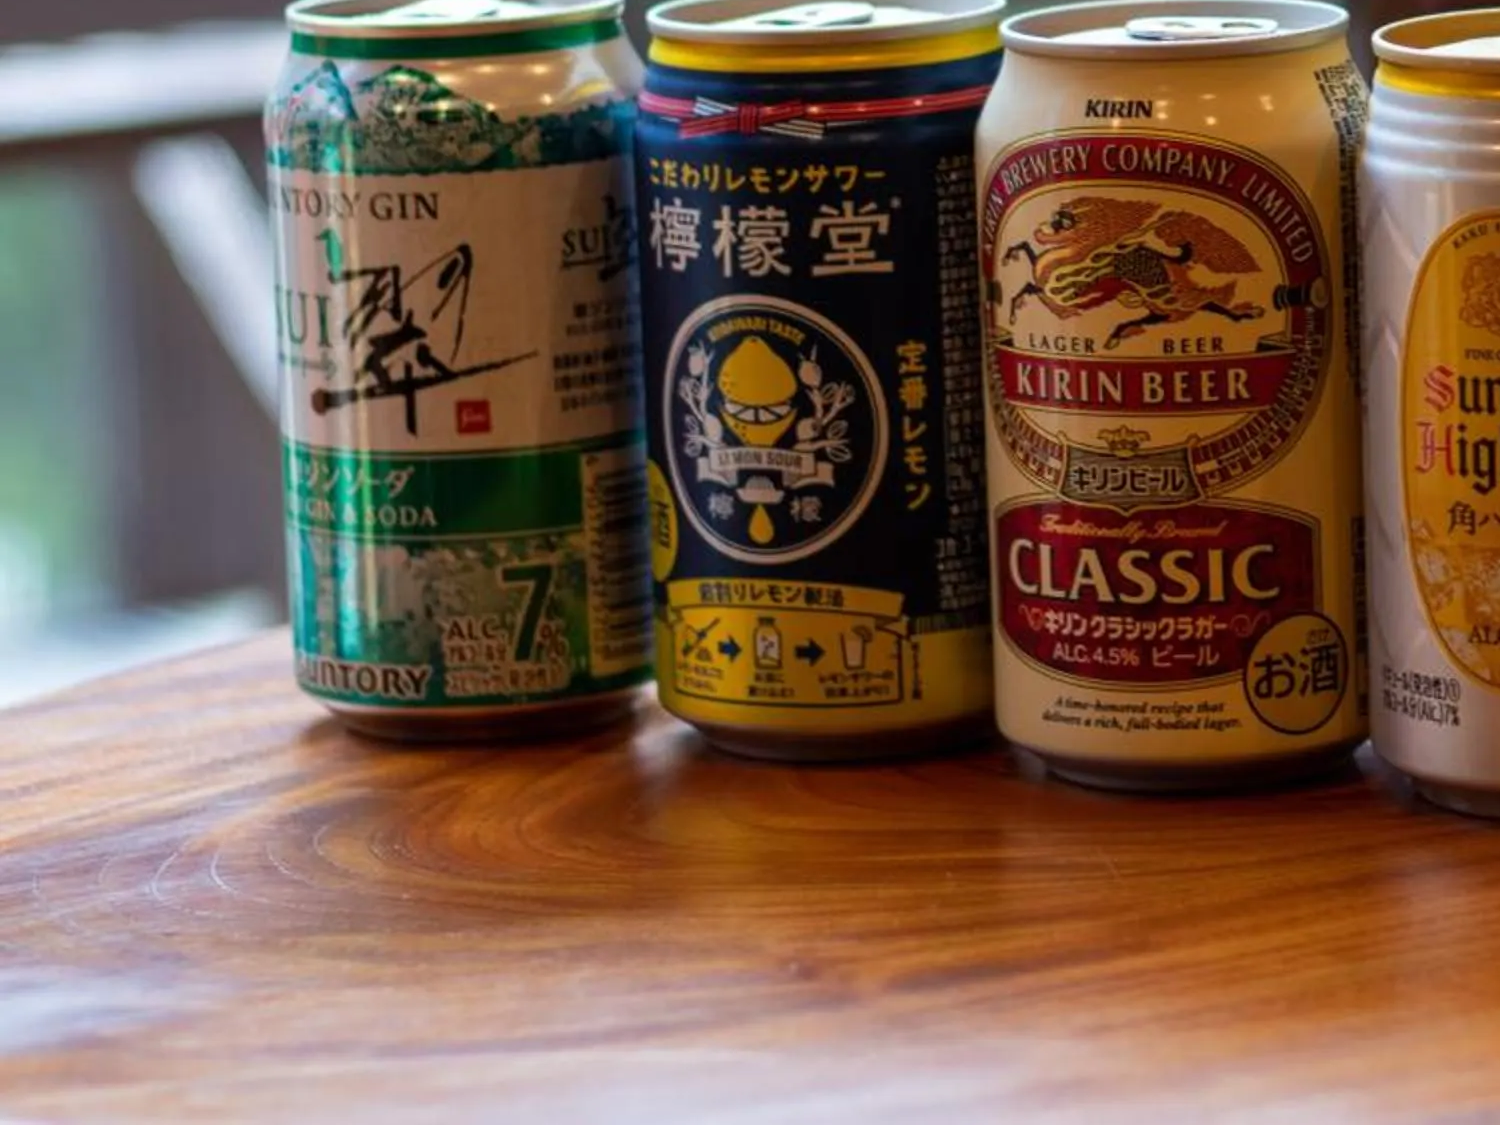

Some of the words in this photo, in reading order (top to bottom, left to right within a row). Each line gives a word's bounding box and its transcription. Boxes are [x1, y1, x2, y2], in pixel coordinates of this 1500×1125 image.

[1086, 99, 1154, 119] KIRIN
[649, 158, 887, 194] こだわりレモンサワー
[369, 192, 439, 220] GIN
[1001, 143, 1092, 196] BREWERY
[1241, 174, 1313, 263] LIMITED
[650, 197, 895, 278] 檸檬堂
[1029, 333, 1096, 353] LAGER
[1162, 337, 1225, 354] BEER
[1016, 362, 1124, 404] KIRIN
[1141, 368, 1252, 404] BEER
[1071, 466, 1188, 495] キリンビール
[1009, 539, 1281, 605] CLASSIC
[1152, 644, 1221, 668] ビール
[1253, 642, 1341, 700] お酒
[299, 656, 428, 698] UNTORY
